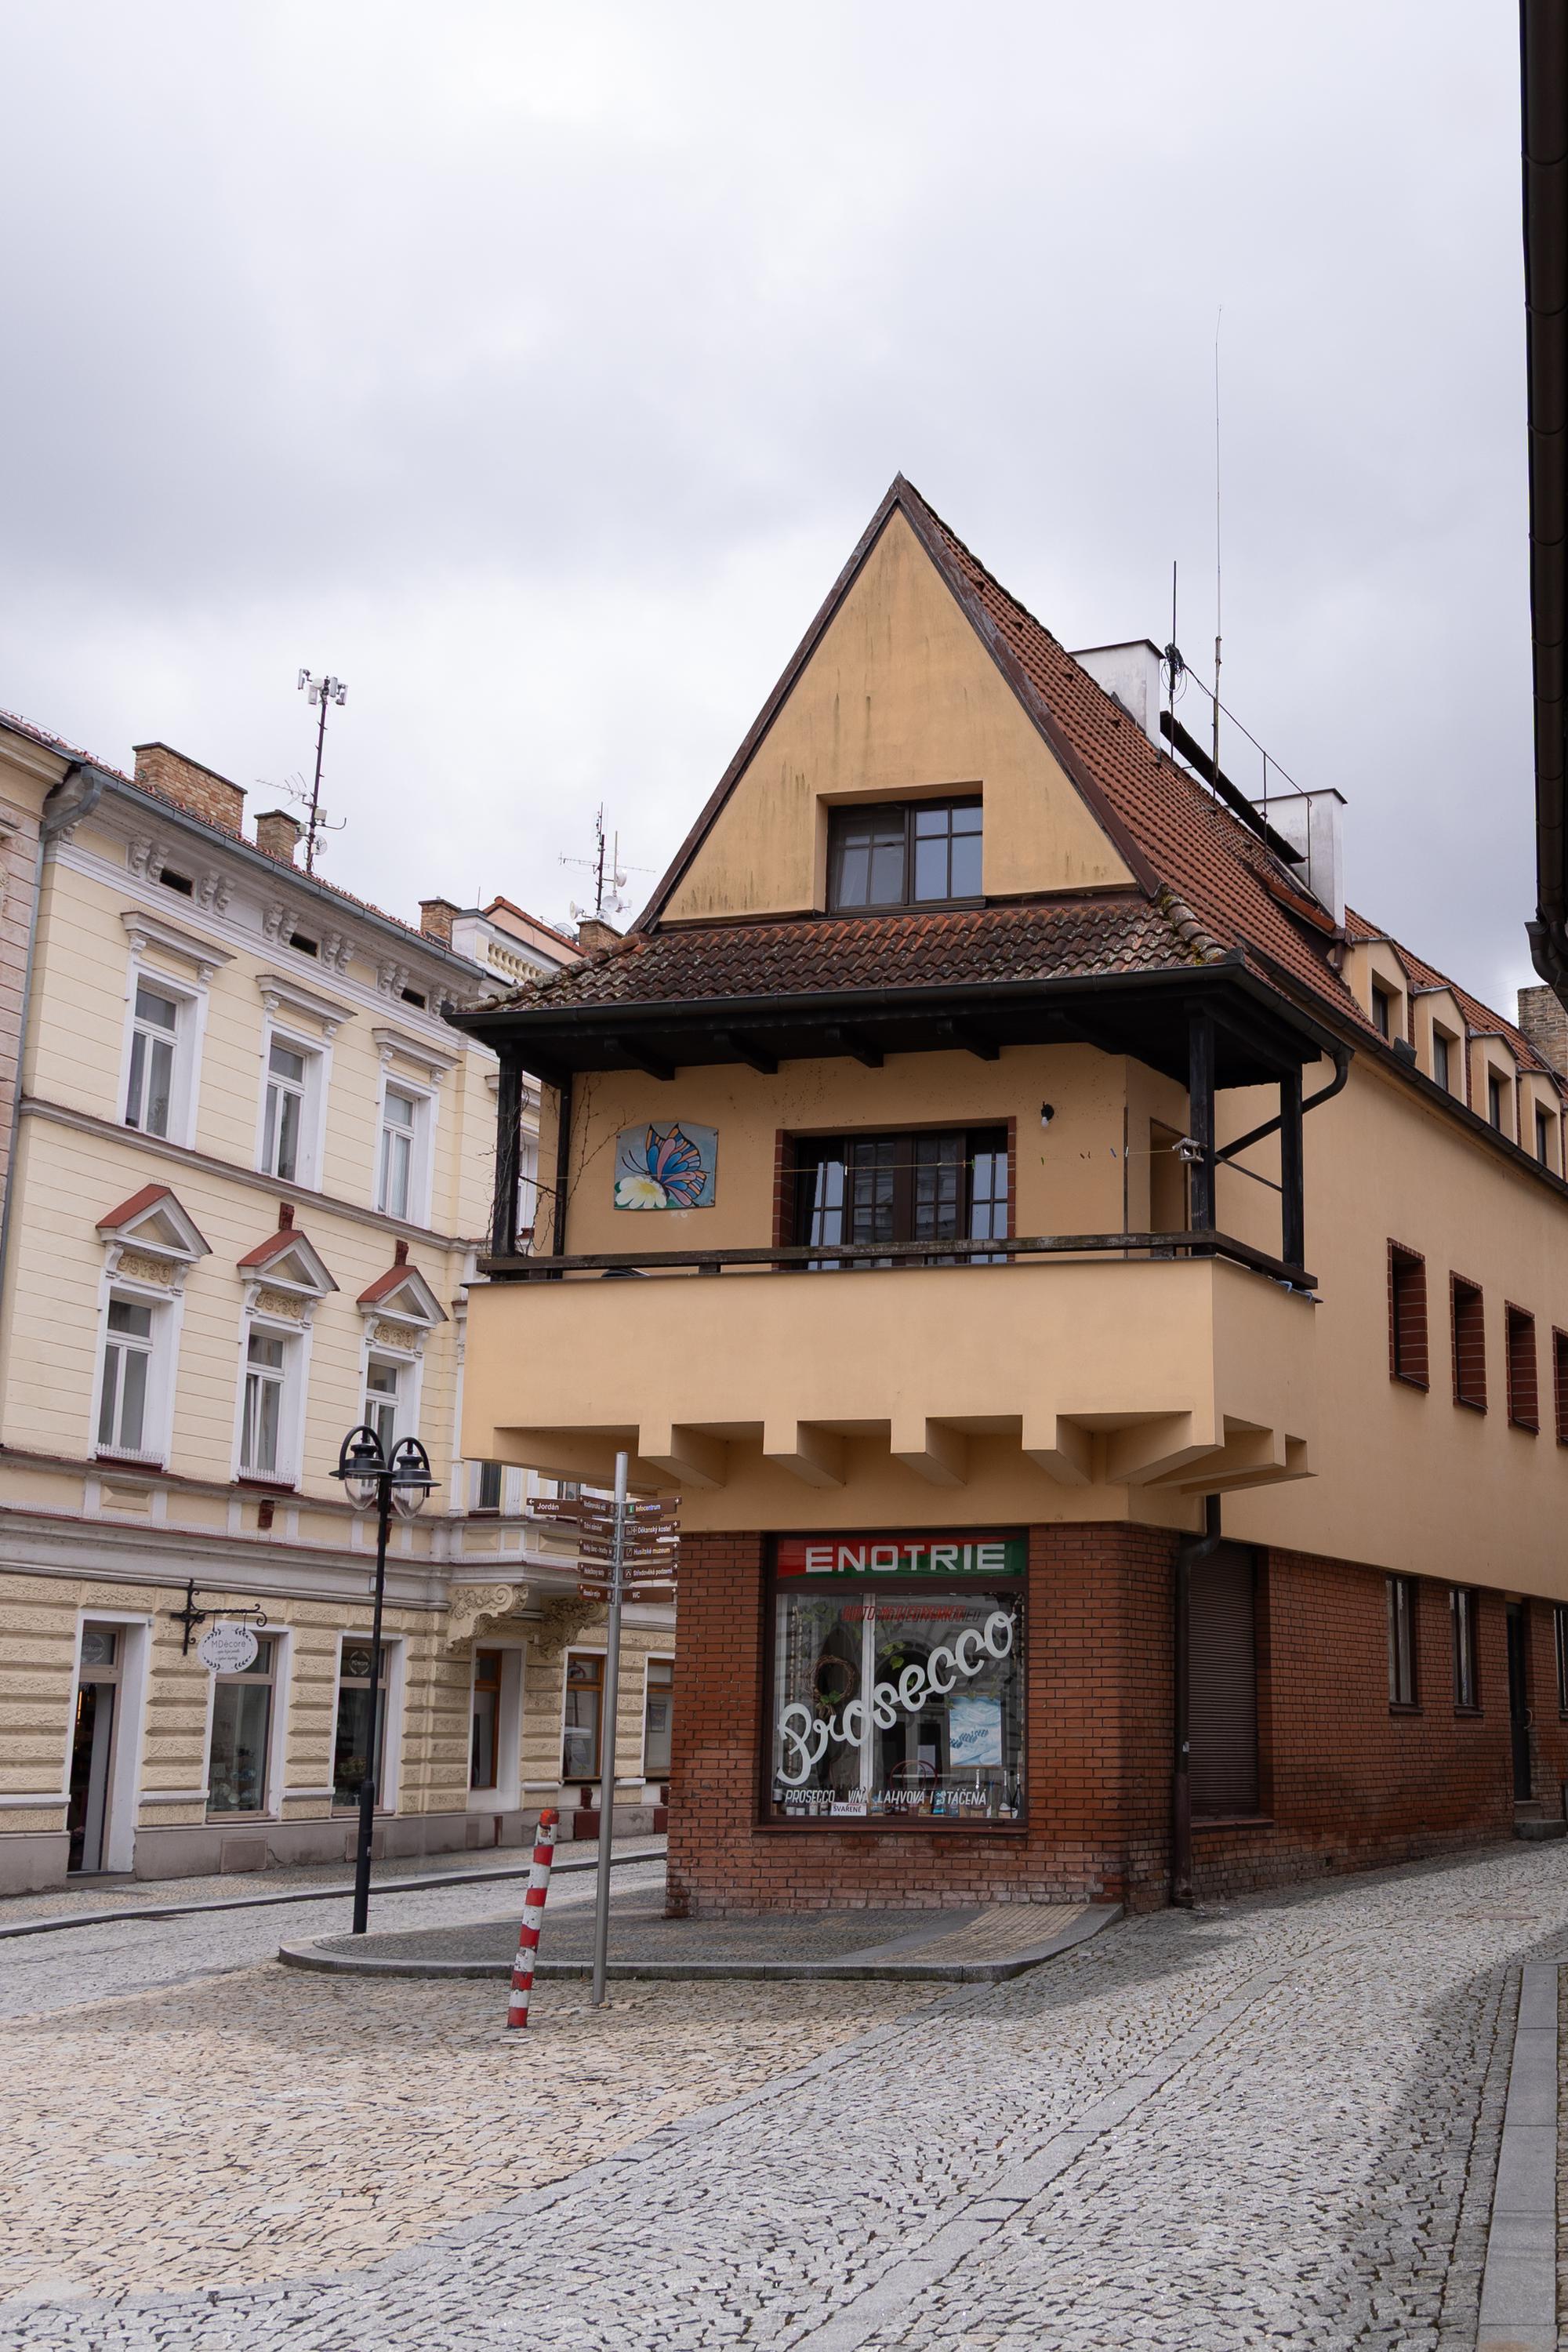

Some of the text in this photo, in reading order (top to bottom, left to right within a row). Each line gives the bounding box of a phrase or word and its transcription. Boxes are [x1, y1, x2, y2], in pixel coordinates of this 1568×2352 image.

[537, 1502, 559, 1511] Jordán
[805, 1544, 1005, 1573] ENOTRIE
[777, 1610, 1017, 1786] Prosecco
[785, 1790, 836, 1803] PROSECCO
[878, 1788, 926, 1805] LAHVOVÁ
[939, 1788, 986, 1806] STÁČENÁ
[833, 1804, 862, 1813] SVAŘENÉ
